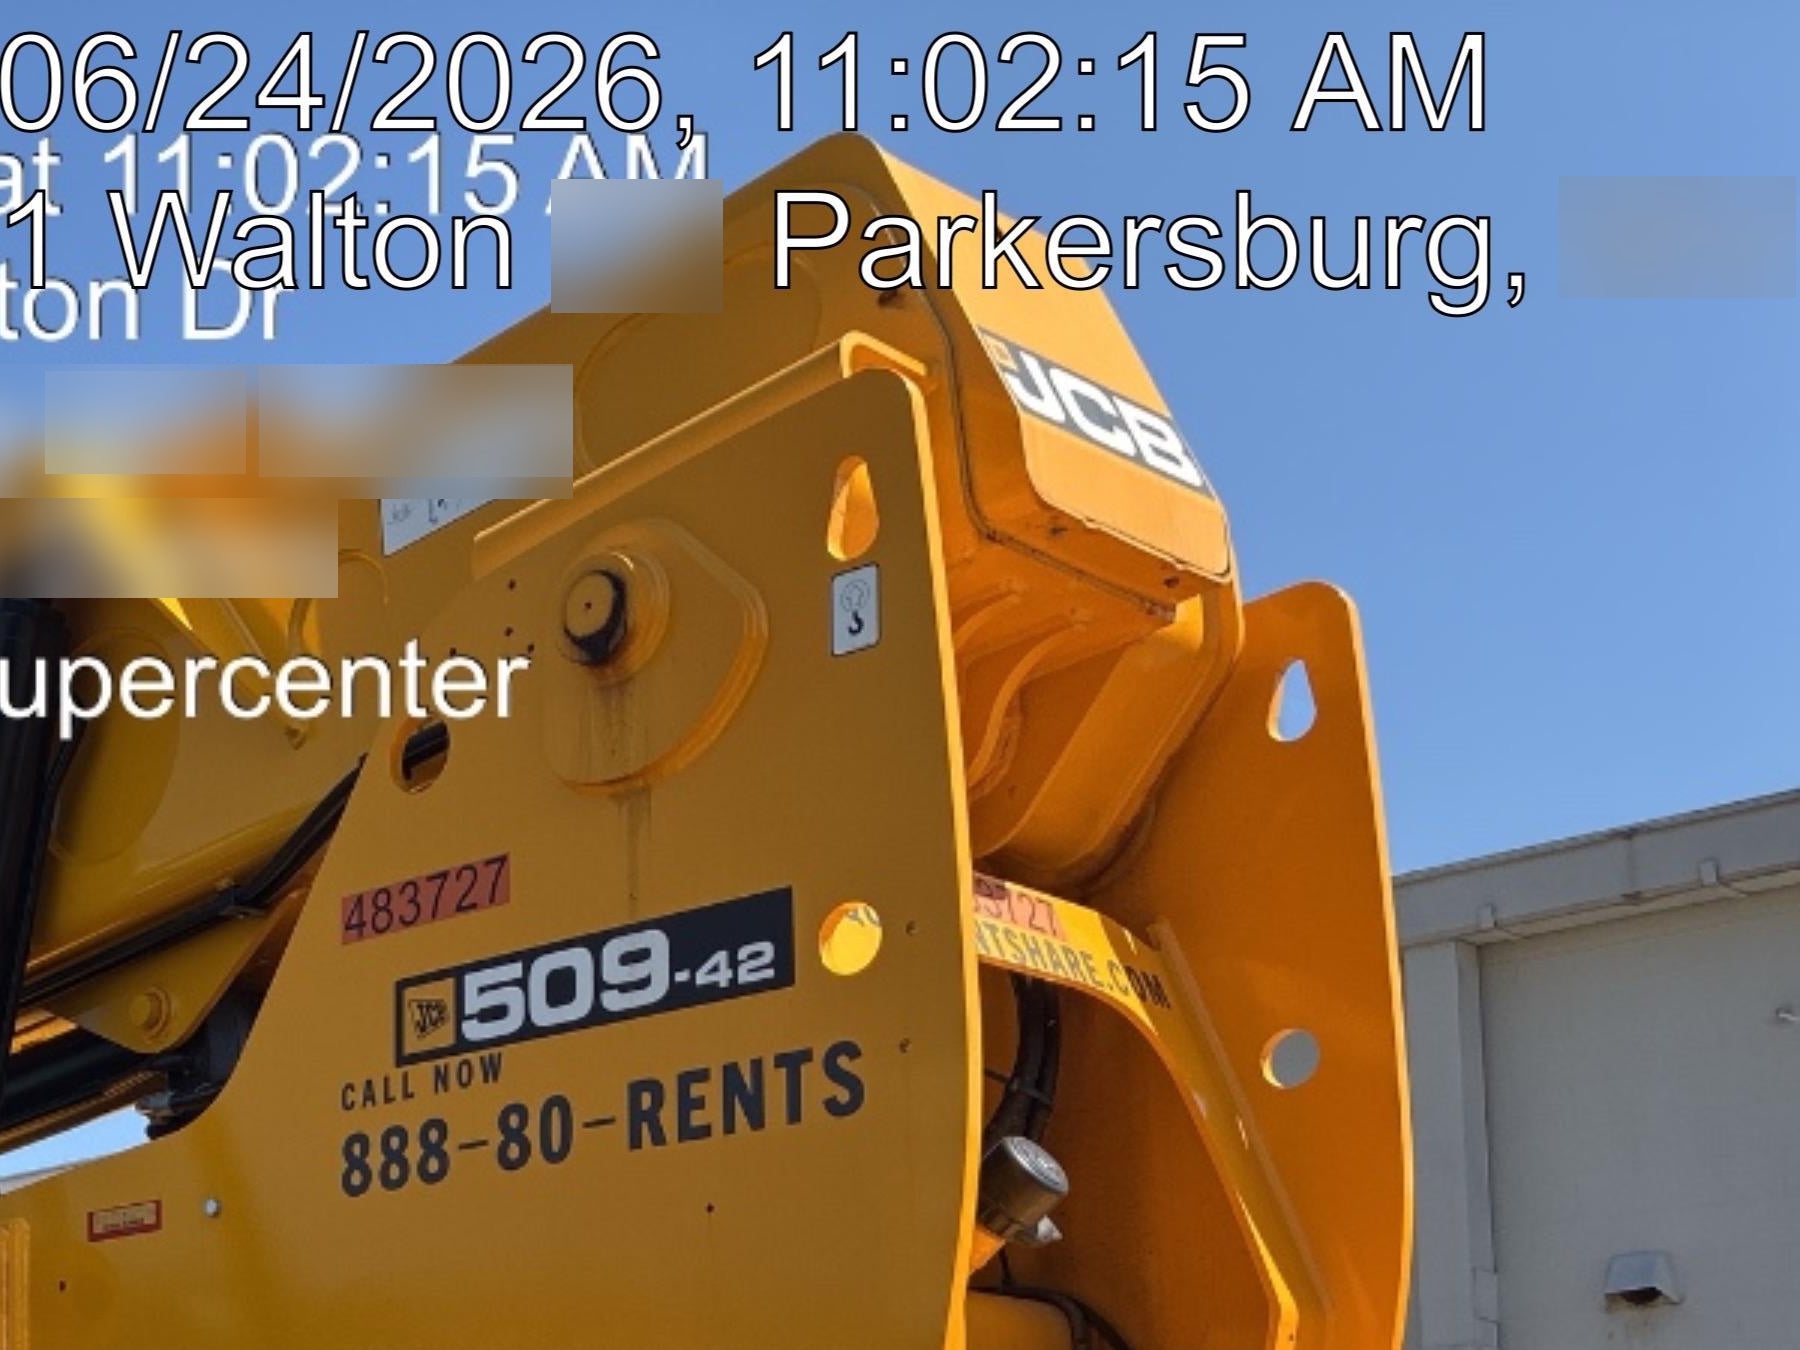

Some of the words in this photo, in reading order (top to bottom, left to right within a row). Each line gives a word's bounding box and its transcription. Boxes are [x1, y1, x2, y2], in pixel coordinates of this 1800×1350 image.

[1000, 350, 1203, 488] JCB
[344, 854, 508, 941] 483727
[460, 928, 777, 1042] 509-42
[340, 1070, 415, 1111] CALL
[432, 1052, 503, 1095] NOW
[341, 1040, 866, 1198] 888-80-RENTS
